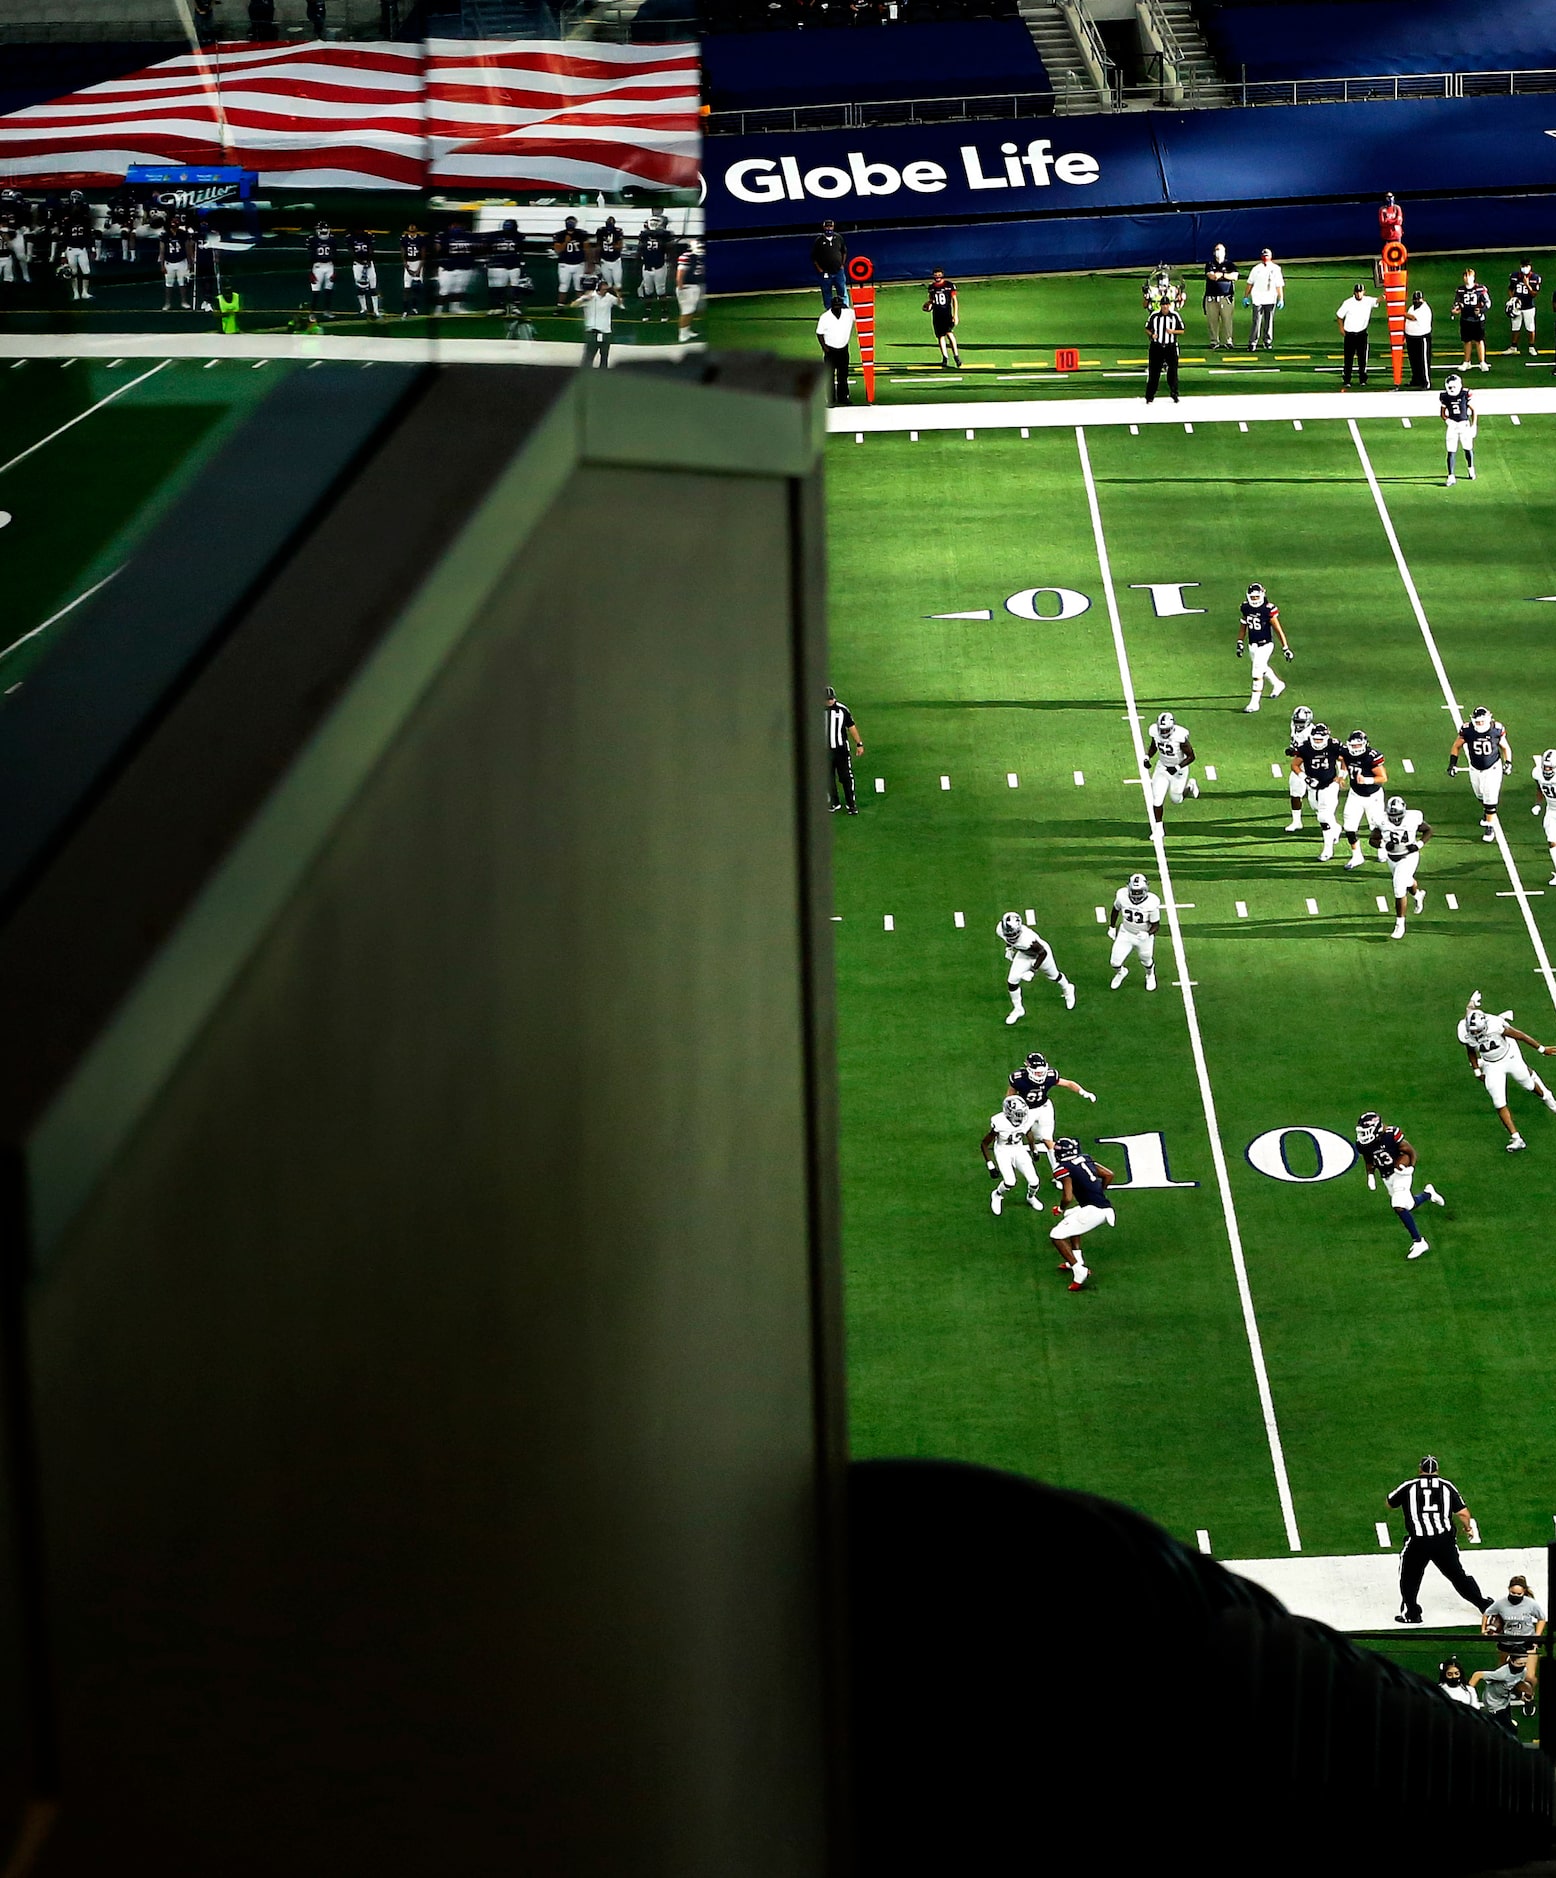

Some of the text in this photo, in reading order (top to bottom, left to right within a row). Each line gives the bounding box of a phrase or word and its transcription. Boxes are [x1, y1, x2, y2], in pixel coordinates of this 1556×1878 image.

[725, 139, 1100, 203] Globe Life
[1463, 293, 1478, 305] 23
[1059, 350, 1075, 369] 10
[1452, 404, 1461, 415] 2
[1246, 615, 1262, 630] 56
[1157, 742, 1176, 757] 52
[1473, 740, 1493, 756] 50
[1310, 758, 1330, 770] 54
[1390, 830, 1409, 845] 64
[1123, 909, 1144, 923] 33
[1094, 1125, 1359, 1190] 10
[1423, 1488, 1439, 1512] L
